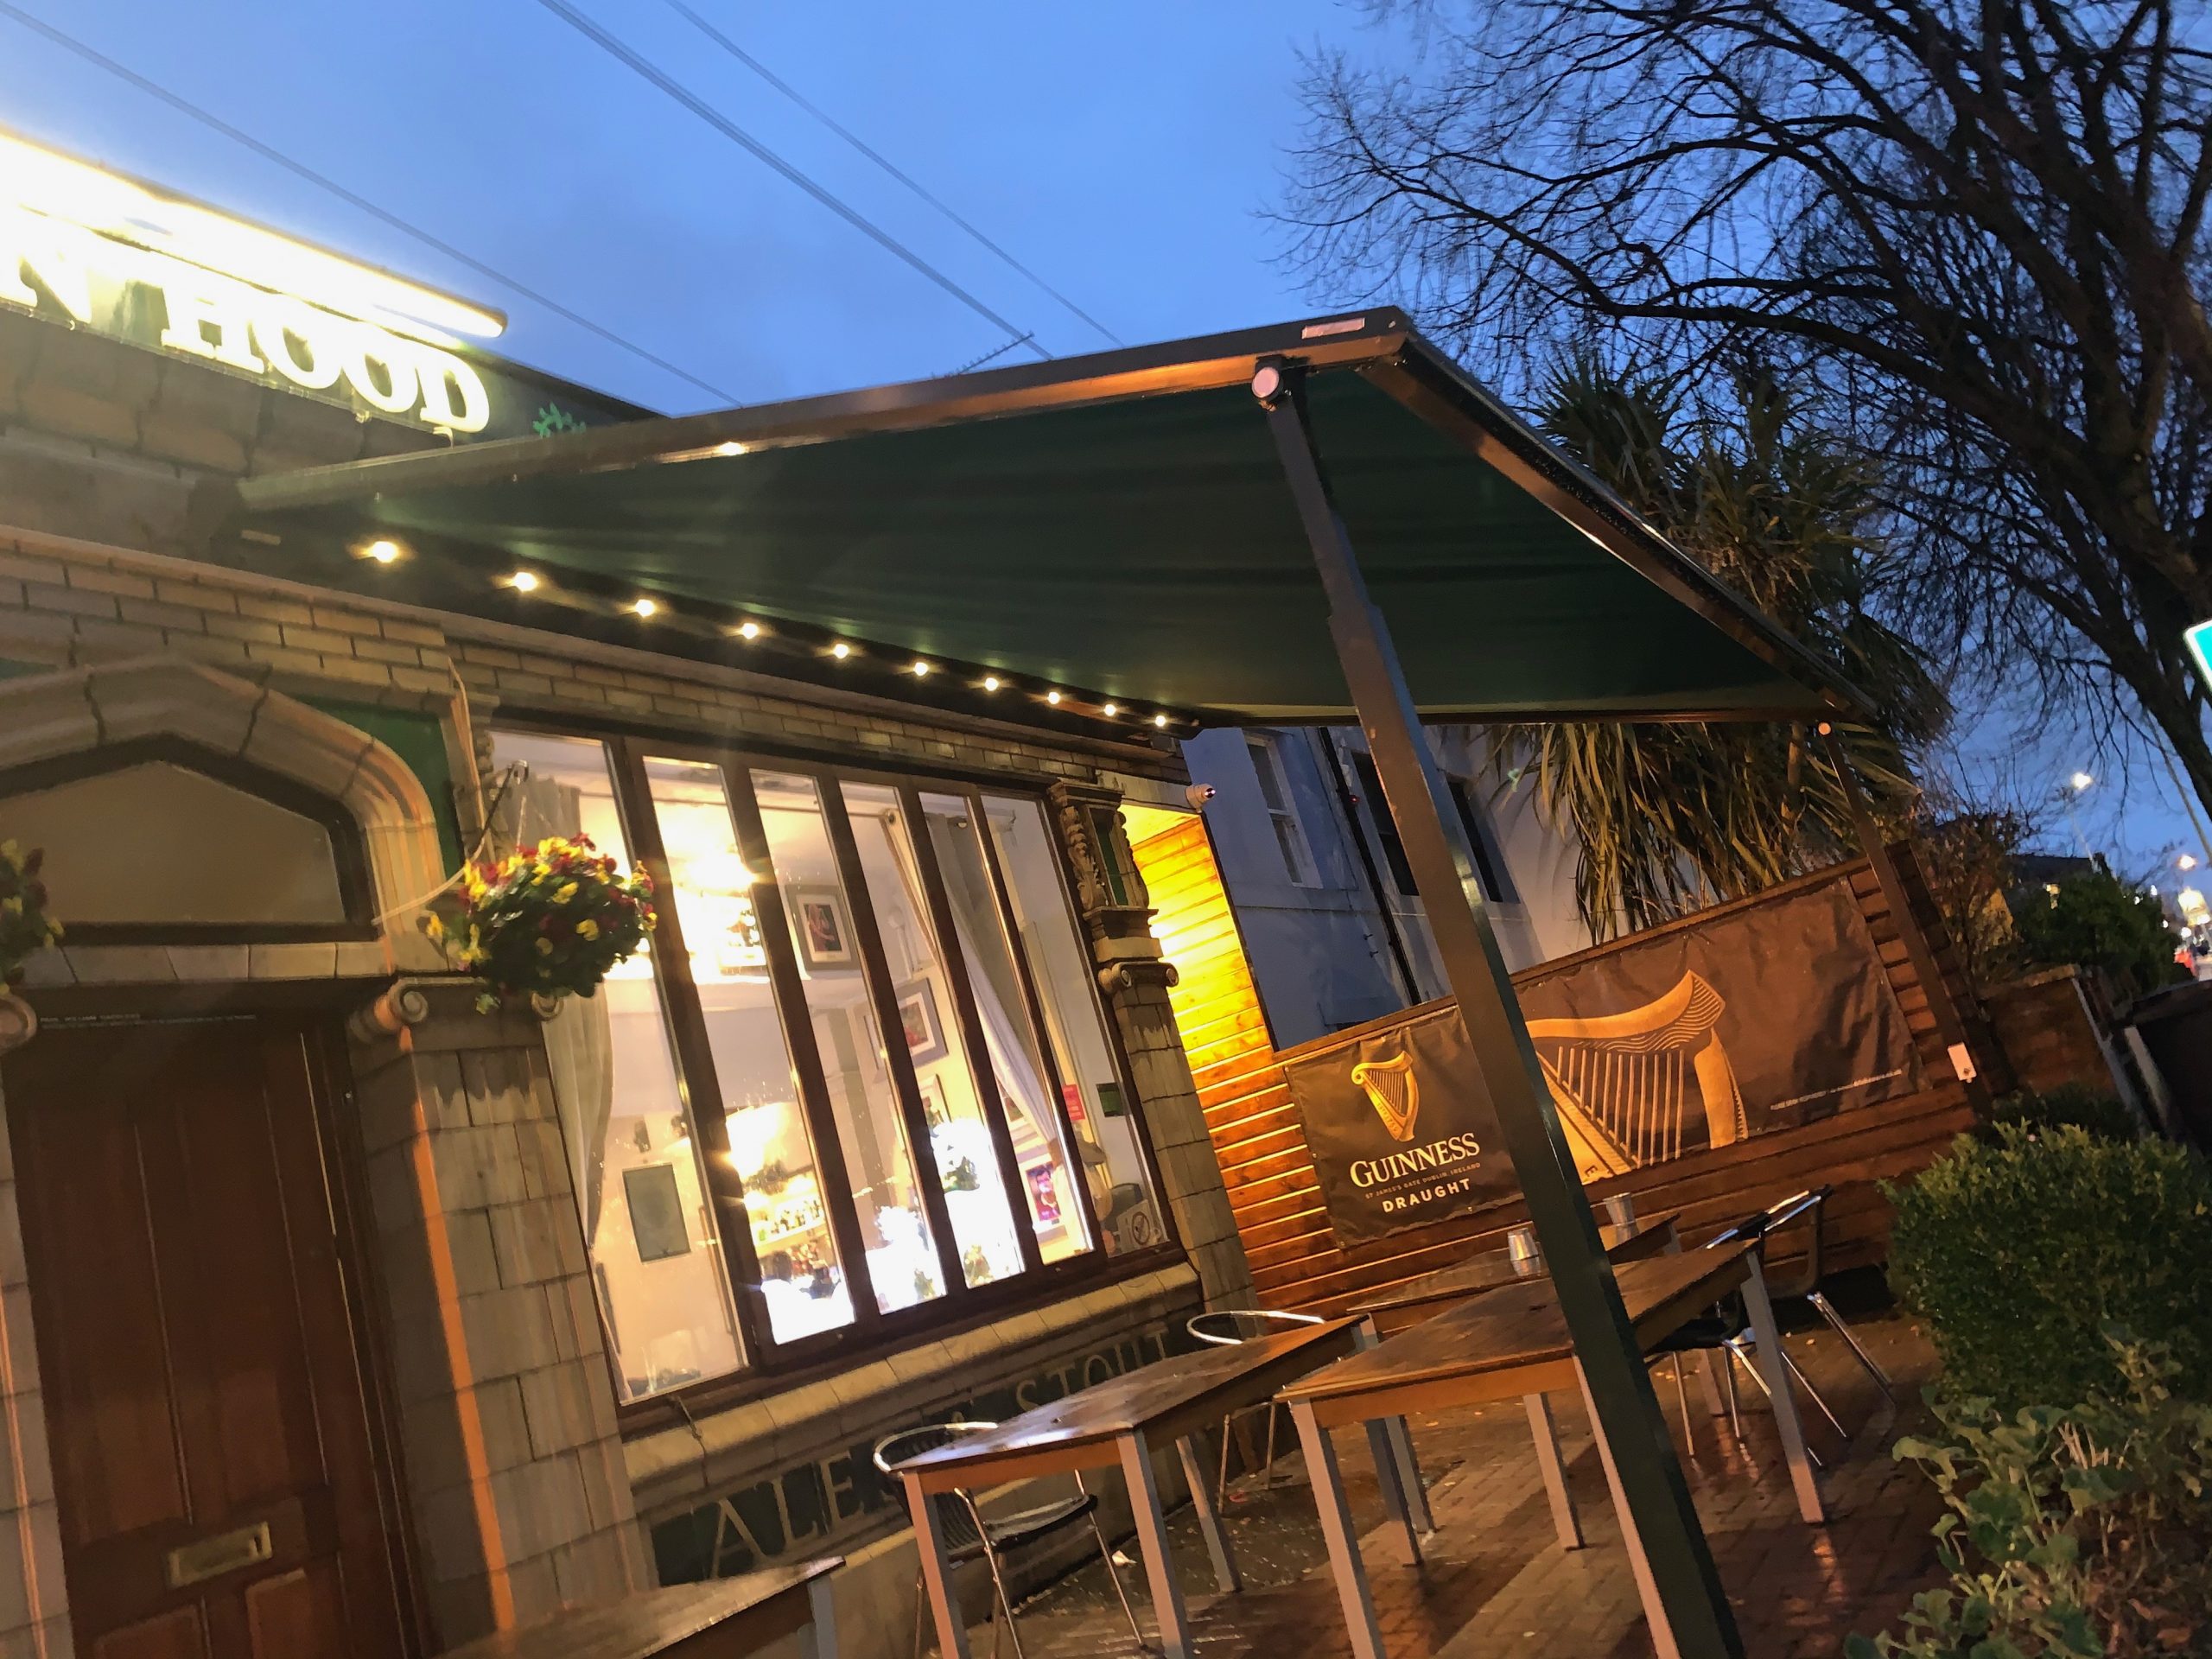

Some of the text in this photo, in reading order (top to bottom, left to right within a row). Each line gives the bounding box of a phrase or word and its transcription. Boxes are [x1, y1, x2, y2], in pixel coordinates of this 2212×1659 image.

[159, 275, 491, 432] HOOD
[1350, 1133, 1480, 1187] GUINNESS
[1403, 1179, 1421, 1189] GATE
[1450, 1162, 1481, 1176] IRELAND
[1382, 1178, 1470, 1212] DRAUGHT
